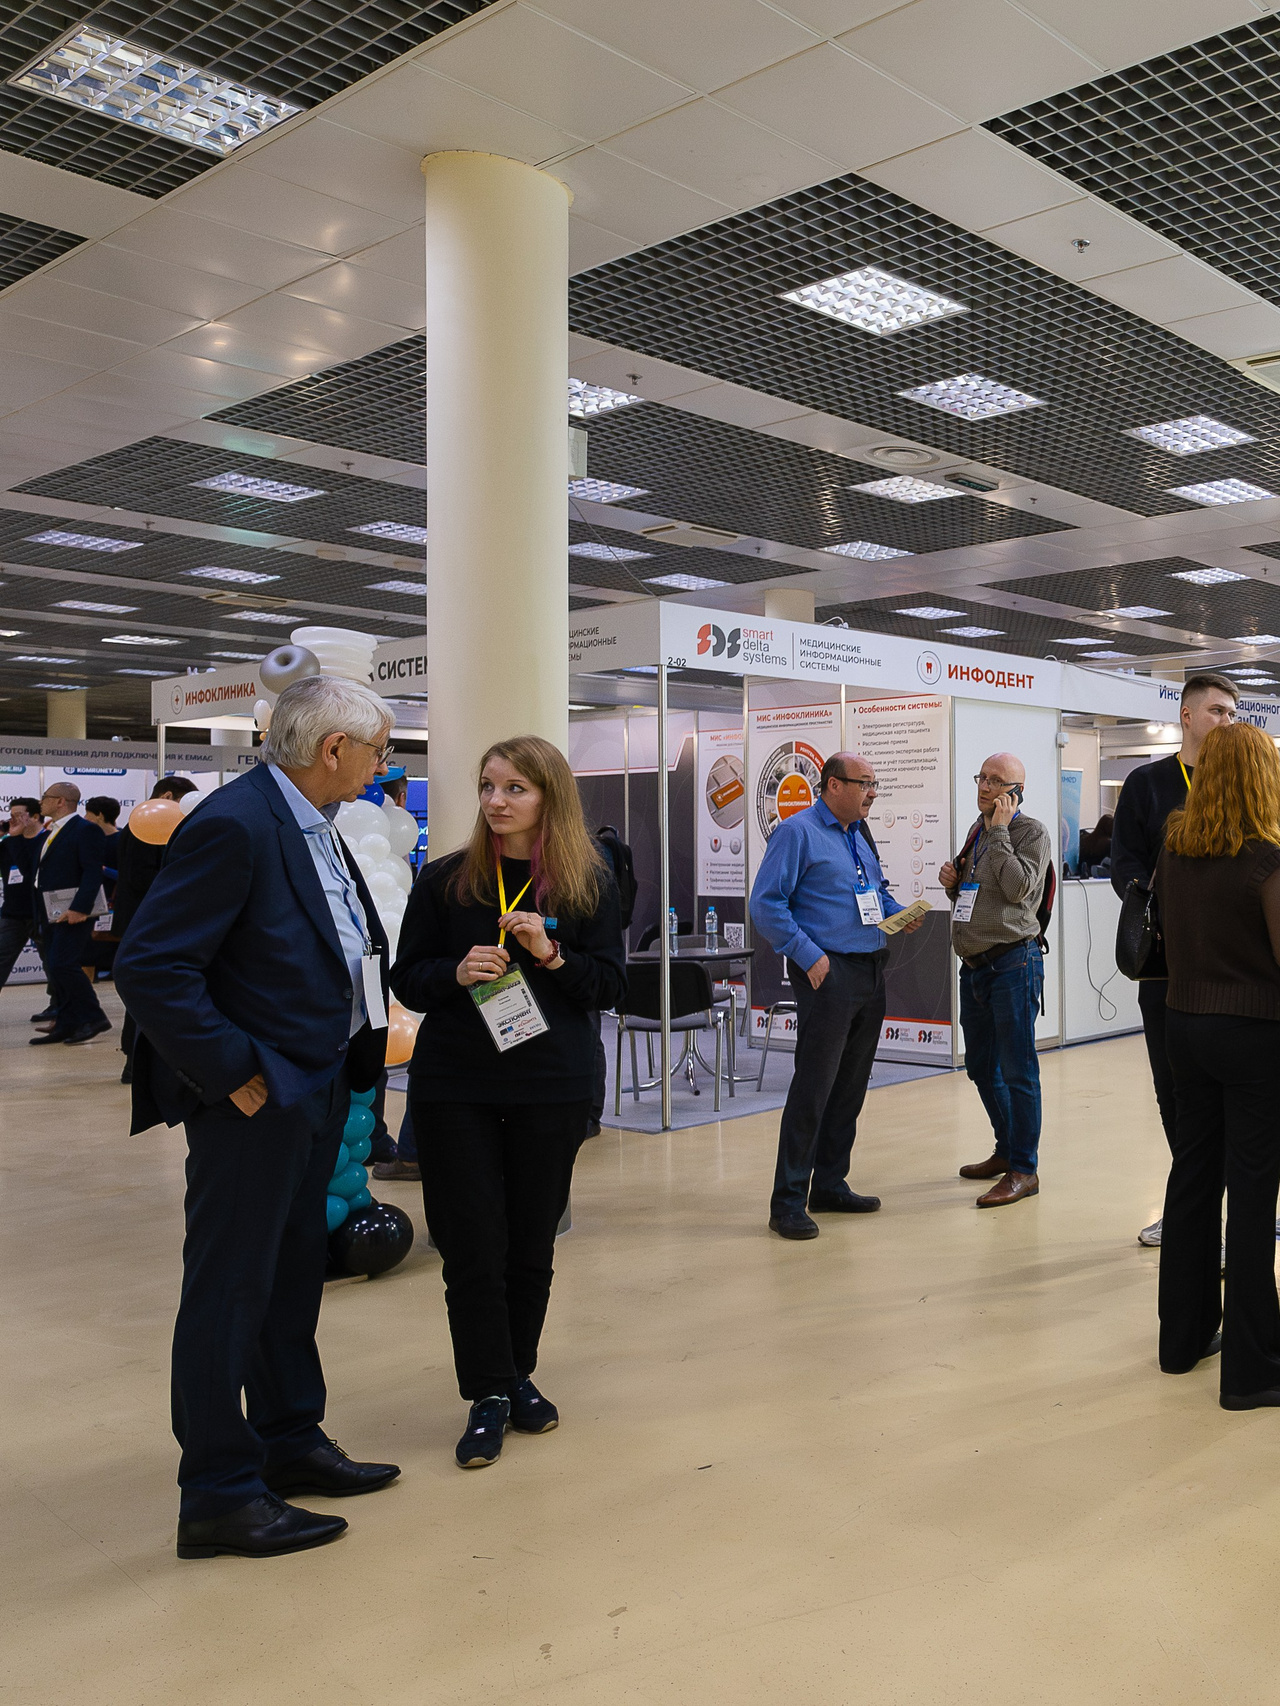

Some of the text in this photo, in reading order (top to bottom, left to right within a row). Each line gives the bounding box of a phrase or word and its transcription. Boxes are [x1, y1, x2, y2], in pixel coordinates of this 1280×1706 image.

[569, 627, 600, 638] ЦИНСКИЕ
[742, 628, 774, 641] smart
[569, 636, 617, 649] РМАЦИОННЫЕ
[742, 639, 770, 652] delta
[799, 638, 862, 653] МЕДИЦИНСКИЕ
[667, 657, 687, 667] 2-02
[742, 652, 788, 666] systems
[799, 650, 882, 667] ИНФОРМАЦИОННЫЕ
[799, 661, 840, 673] СИСТЕМЫ
[947, 664, 1035, 690] ИНФОДЕНТ
[184, 682, 256, 706] ИНФОКЛИНИКА
[1159, 685, 1181, 700] Инс
[858, 701, 943, 714] Особенности системы:
[756, 710, 833, 722] МИС «ИНФОКЛИНИКА»
[862, 720, 925, 730] Электронная регистратура,
[45, 748, 88, 757] РЕШЕНИЯ
[91, 750, 109, 759] ДЛЯ
[111, 751, 176, 761] ПОДКЛЮЧЕИЯ
[923, 746, 940, 754] работа
